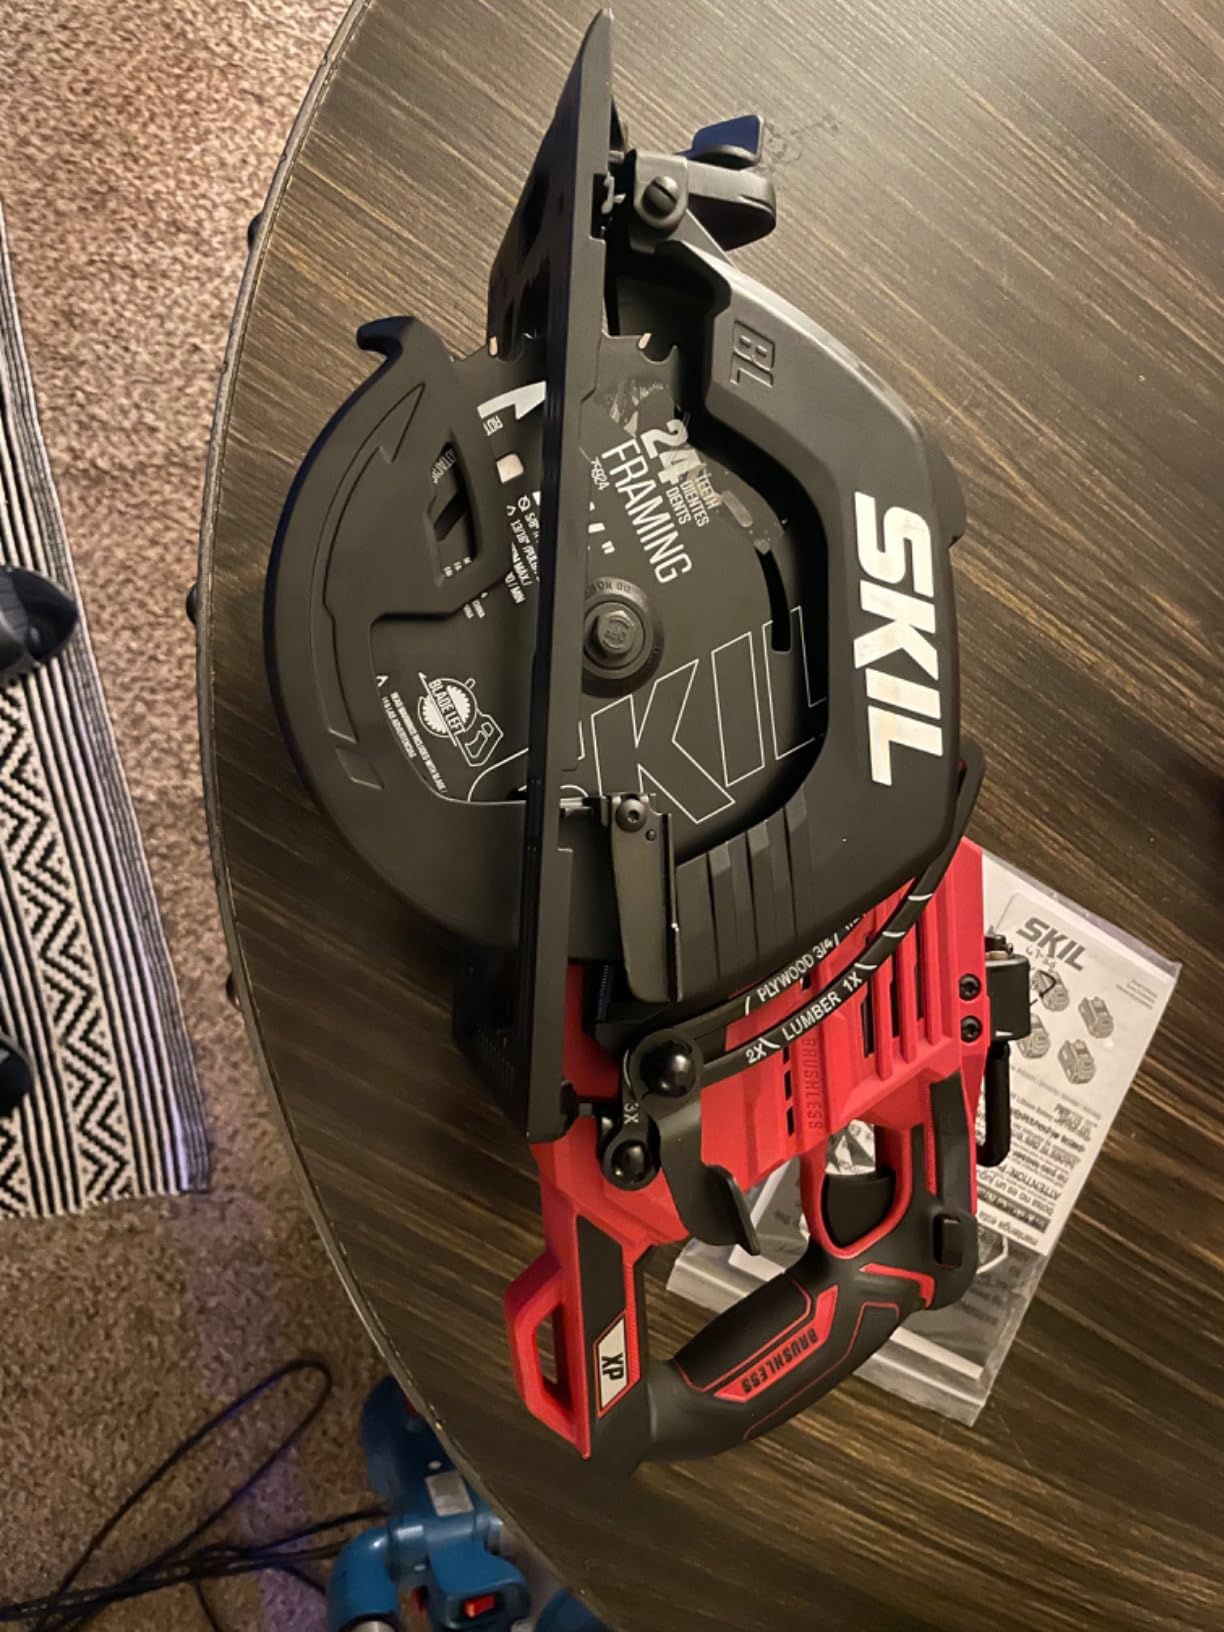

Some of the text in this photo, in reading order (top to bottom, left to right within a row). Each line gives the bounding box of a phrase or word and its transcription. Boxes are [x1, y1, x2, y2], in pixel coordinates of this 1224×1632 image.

[730, 320, 776, 388] BL
[641, 419, 706, 485] 24
[602, 439, 692, 583] FRAMING
[666, 487, 691, 524] DENTS
[681, 480, 710, 527] DIENTES
[697, 472, 721, 509] TEETH
[853, 492, 944, 787] SKIL
[428, 679, 466, 736] BLADE LEFT
[1016, 917, 1086, 971] SKIL
[757, 953, 814, 1002] PLYWOOD
[746, 971, 862, 1064] 2X LUMBER 1X
[800, 1038, 824, 1130] BRUSHLESS
[623, 1102, 640, 1124] 3X
[601, 1353, 625, 1380] XP
[741, 1328, 818, 1393] BRUSHLESS
